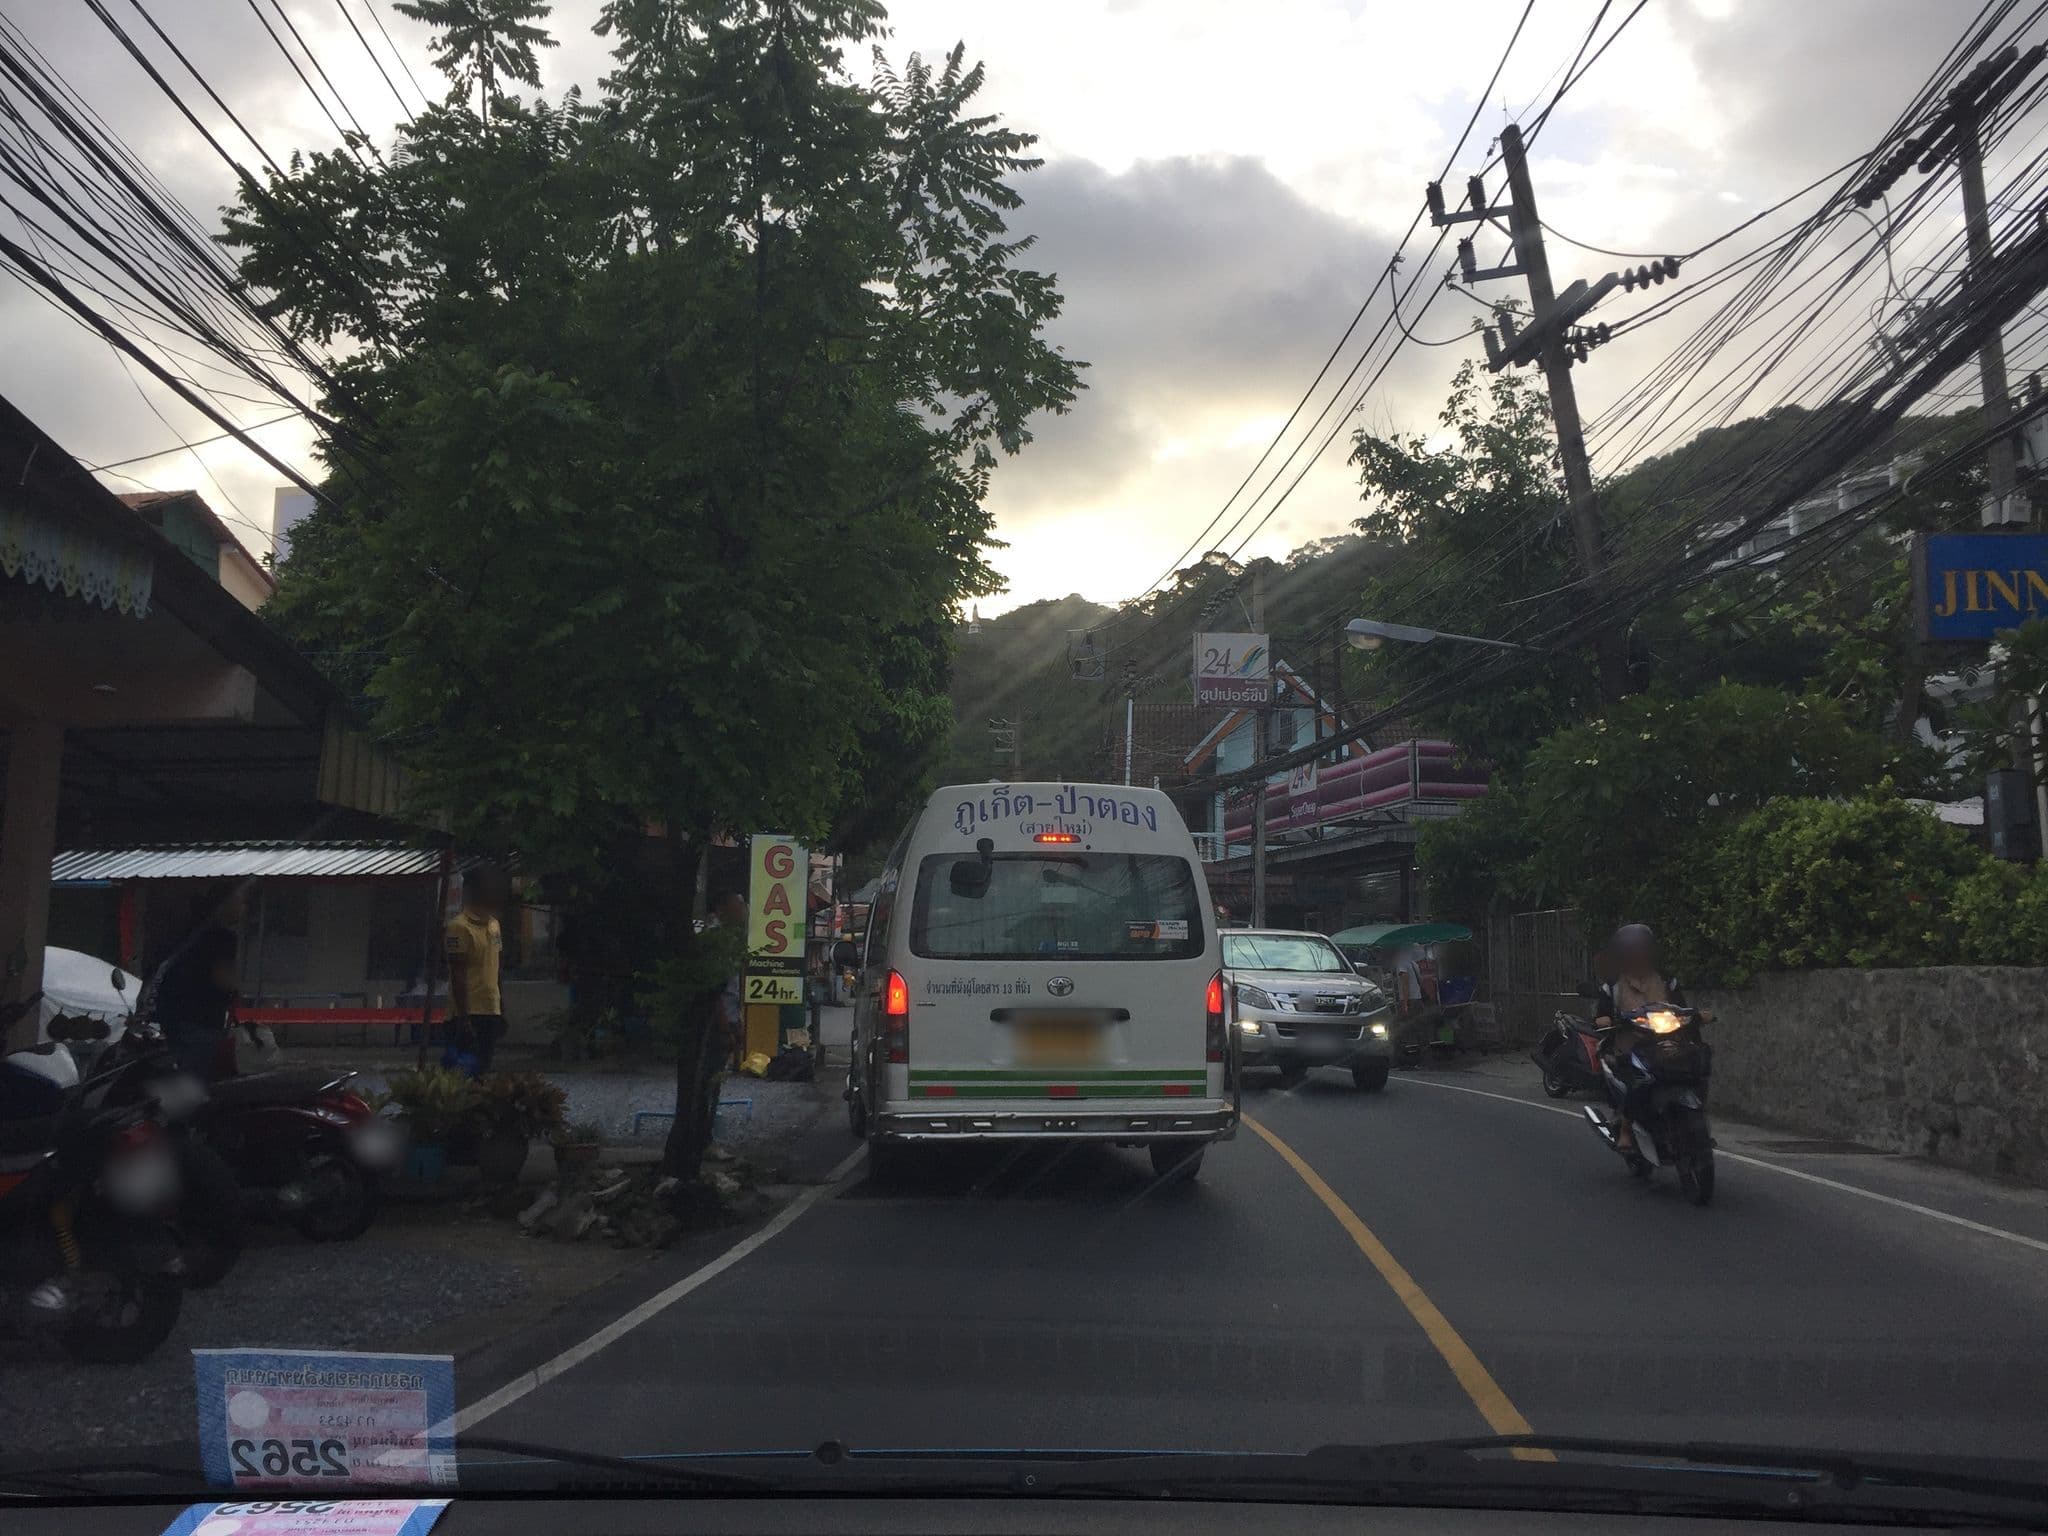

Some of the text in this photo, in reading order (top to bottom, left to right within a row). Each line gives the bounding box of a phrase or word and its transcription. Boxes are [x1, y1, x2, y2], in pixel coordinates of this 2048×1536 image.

[1202, 648, 1232, 674] 24
[954, 785, 1157, 835] ภูเก็ต-ป่าตอง
[763, 845, 795, 954] GAS
[749, 959, 784, 968] Machine
